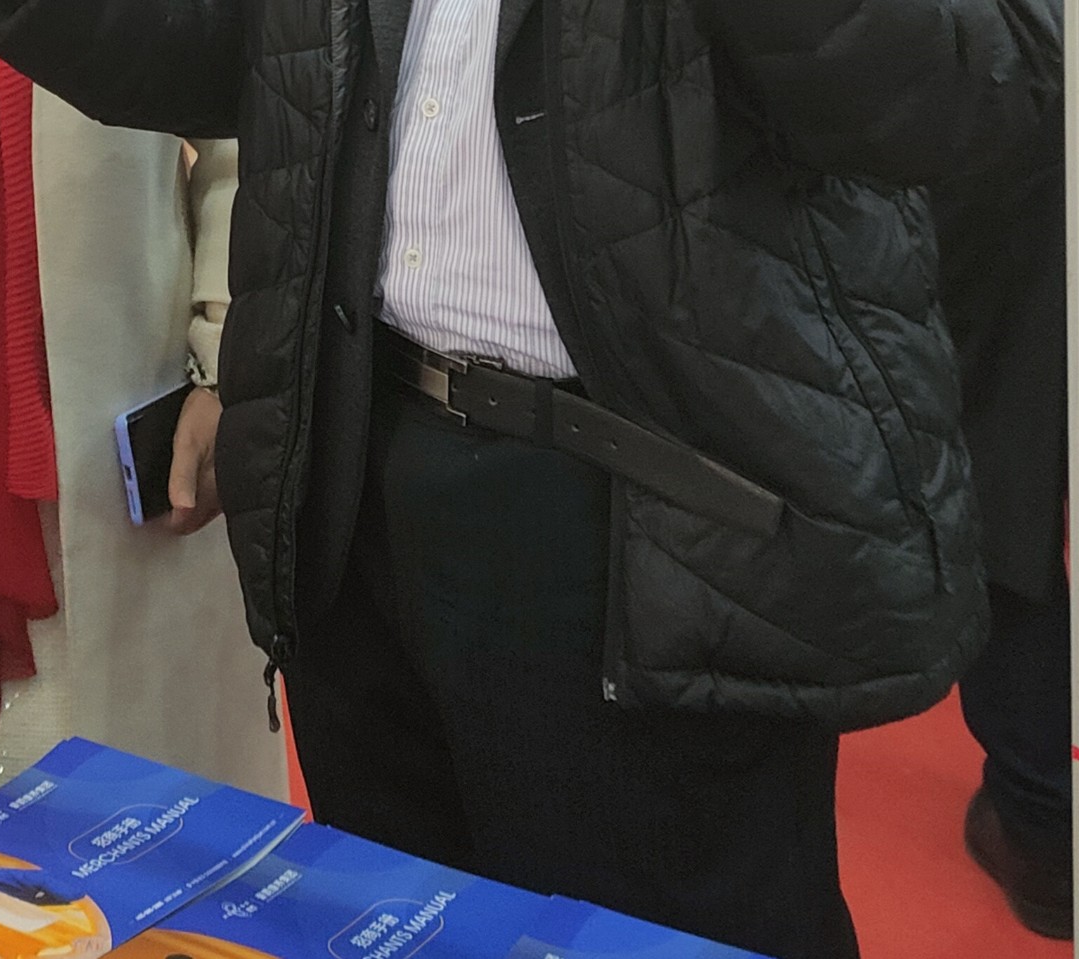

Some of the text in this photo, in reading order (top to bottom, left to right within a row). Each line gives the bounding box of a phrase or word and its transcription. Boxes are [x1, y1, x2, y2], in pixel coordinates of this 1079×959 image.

[71, 826, 151, 880] MERCHANTS
[145, 796, 199, 836] MANUAL
[404, 890, 457, 934] MANUAL
